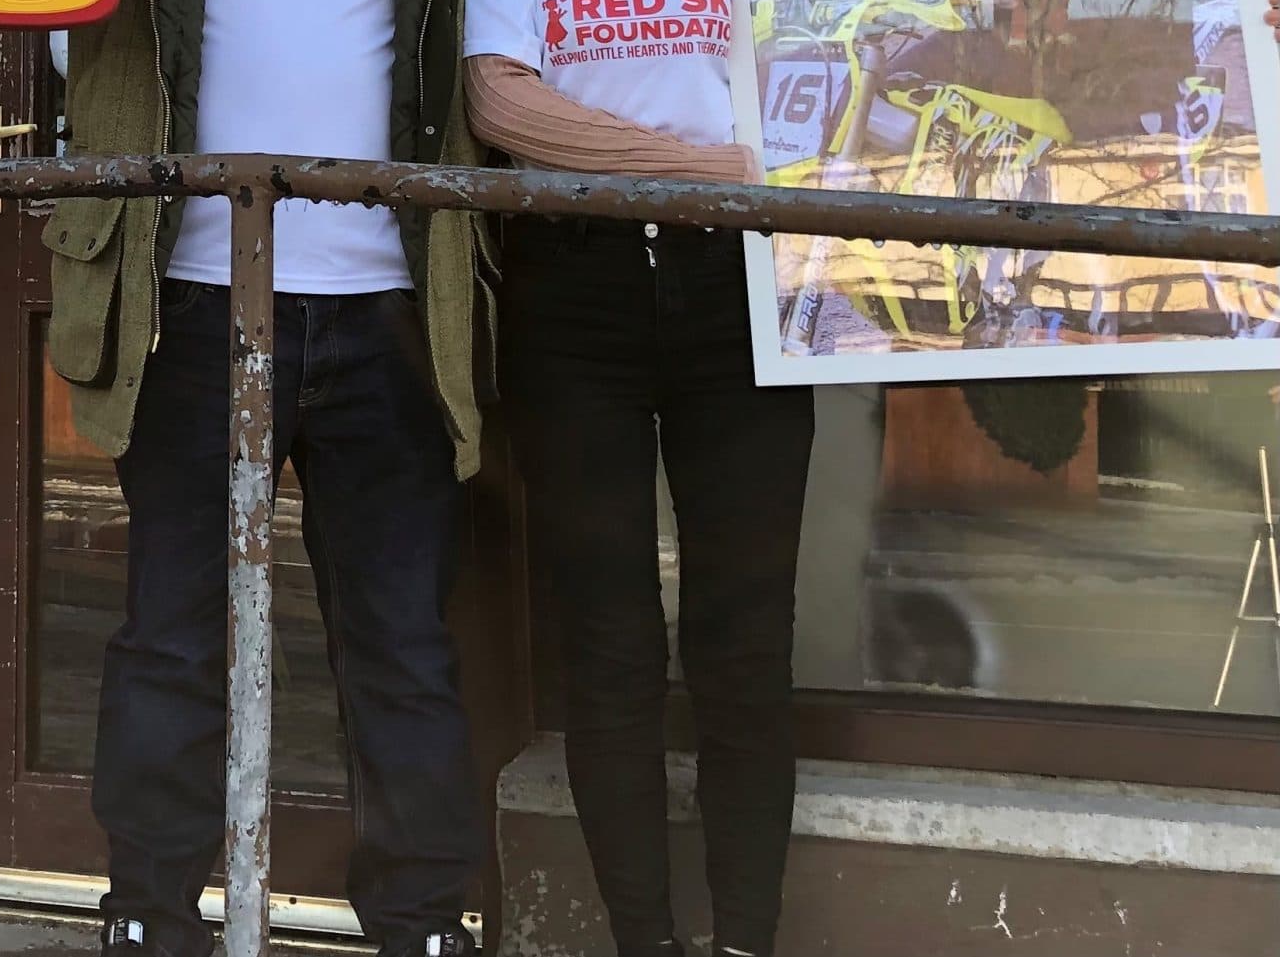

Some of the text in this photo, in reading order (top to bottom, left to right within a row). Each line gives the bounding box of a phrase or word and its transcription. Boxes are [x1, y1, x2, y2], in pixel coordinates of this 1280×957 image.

[575, 18, 731, 47] FOUNDATI
[590, 47, 625, 60] LITTLE
[627, 43, 669, 58] HEARTS
[672, 42, 695, 55] AND
[769, 73, 825, 124] 16
